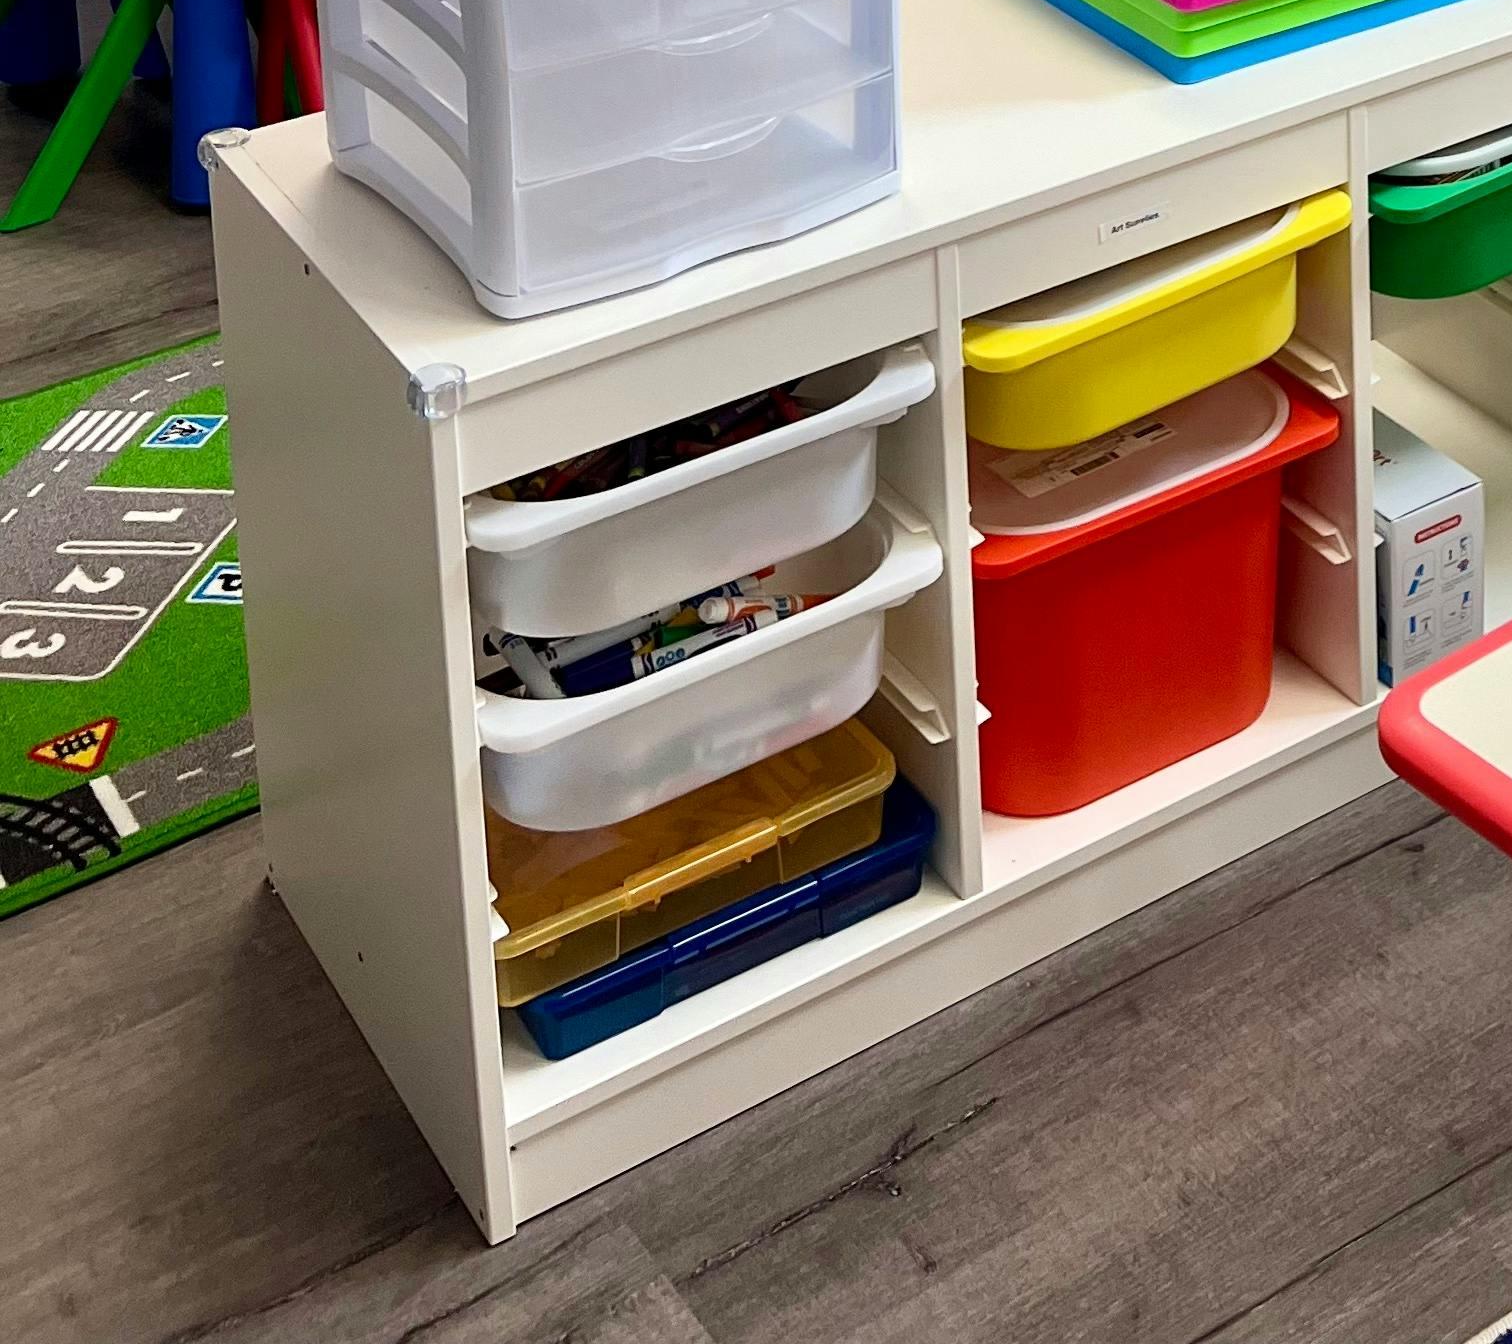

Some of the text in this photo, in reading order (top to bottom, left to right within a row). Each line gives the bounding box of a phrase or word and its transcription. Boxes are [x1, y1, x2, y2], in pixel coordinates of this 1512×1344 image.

[1111, 224, 1124, 234] Art
[52, 565, 125, 595] 2
[0, 627, 67, 661] 3
